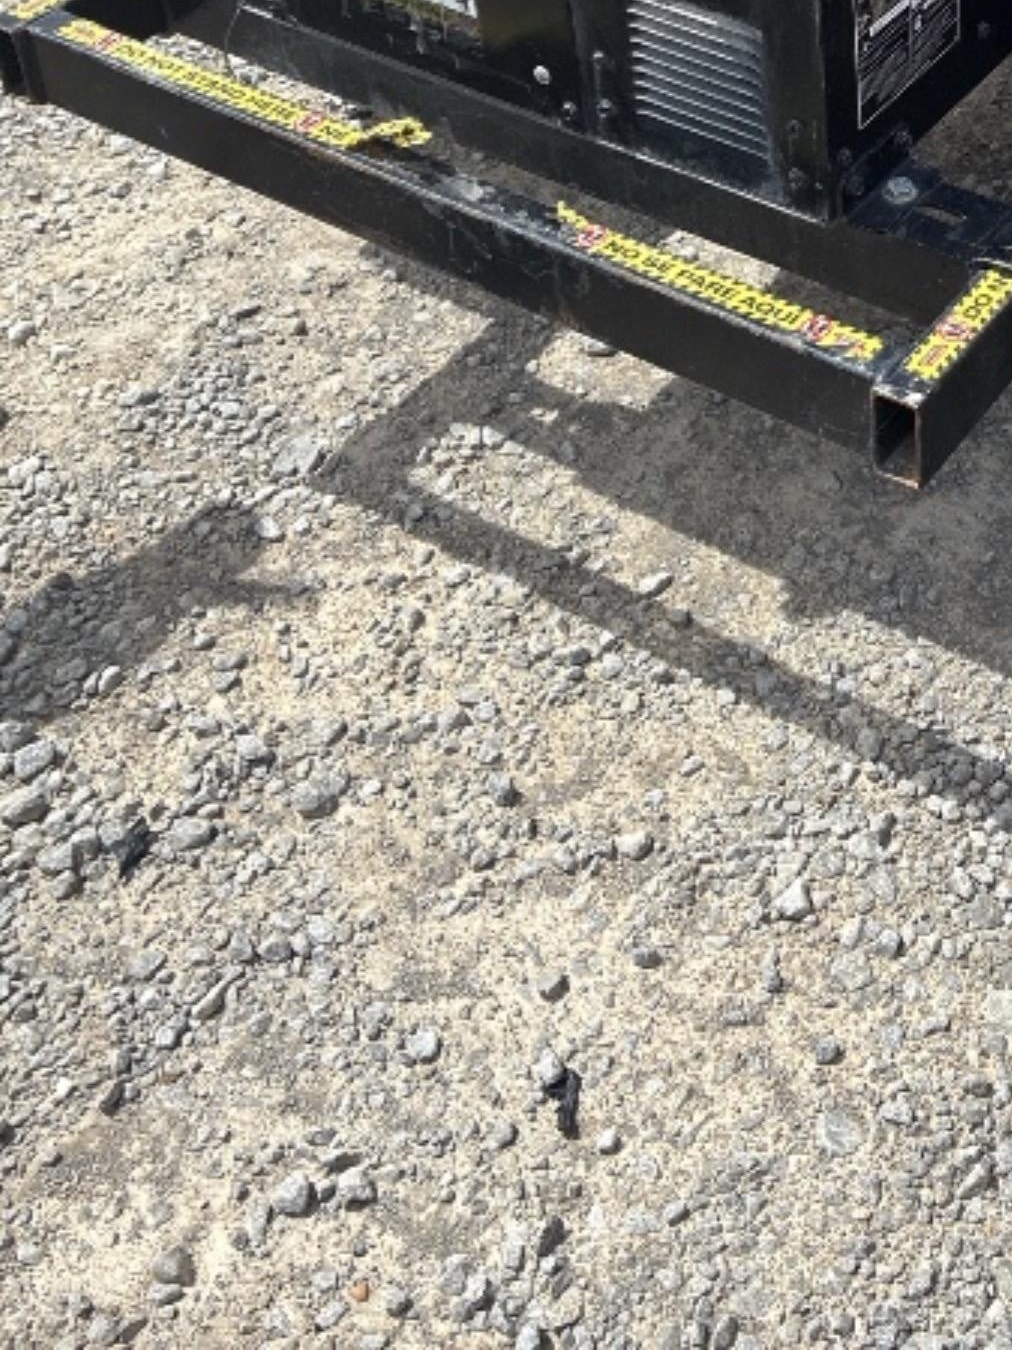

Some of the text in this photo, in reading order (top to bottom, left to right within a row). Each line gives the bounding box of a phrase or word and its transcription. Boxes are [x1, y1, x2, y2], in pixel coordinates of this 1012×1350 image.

[604, 239, 640, 260] NO
[674, 267, 737, 301] PARE
[739, 295, 800, 326] AQUI
